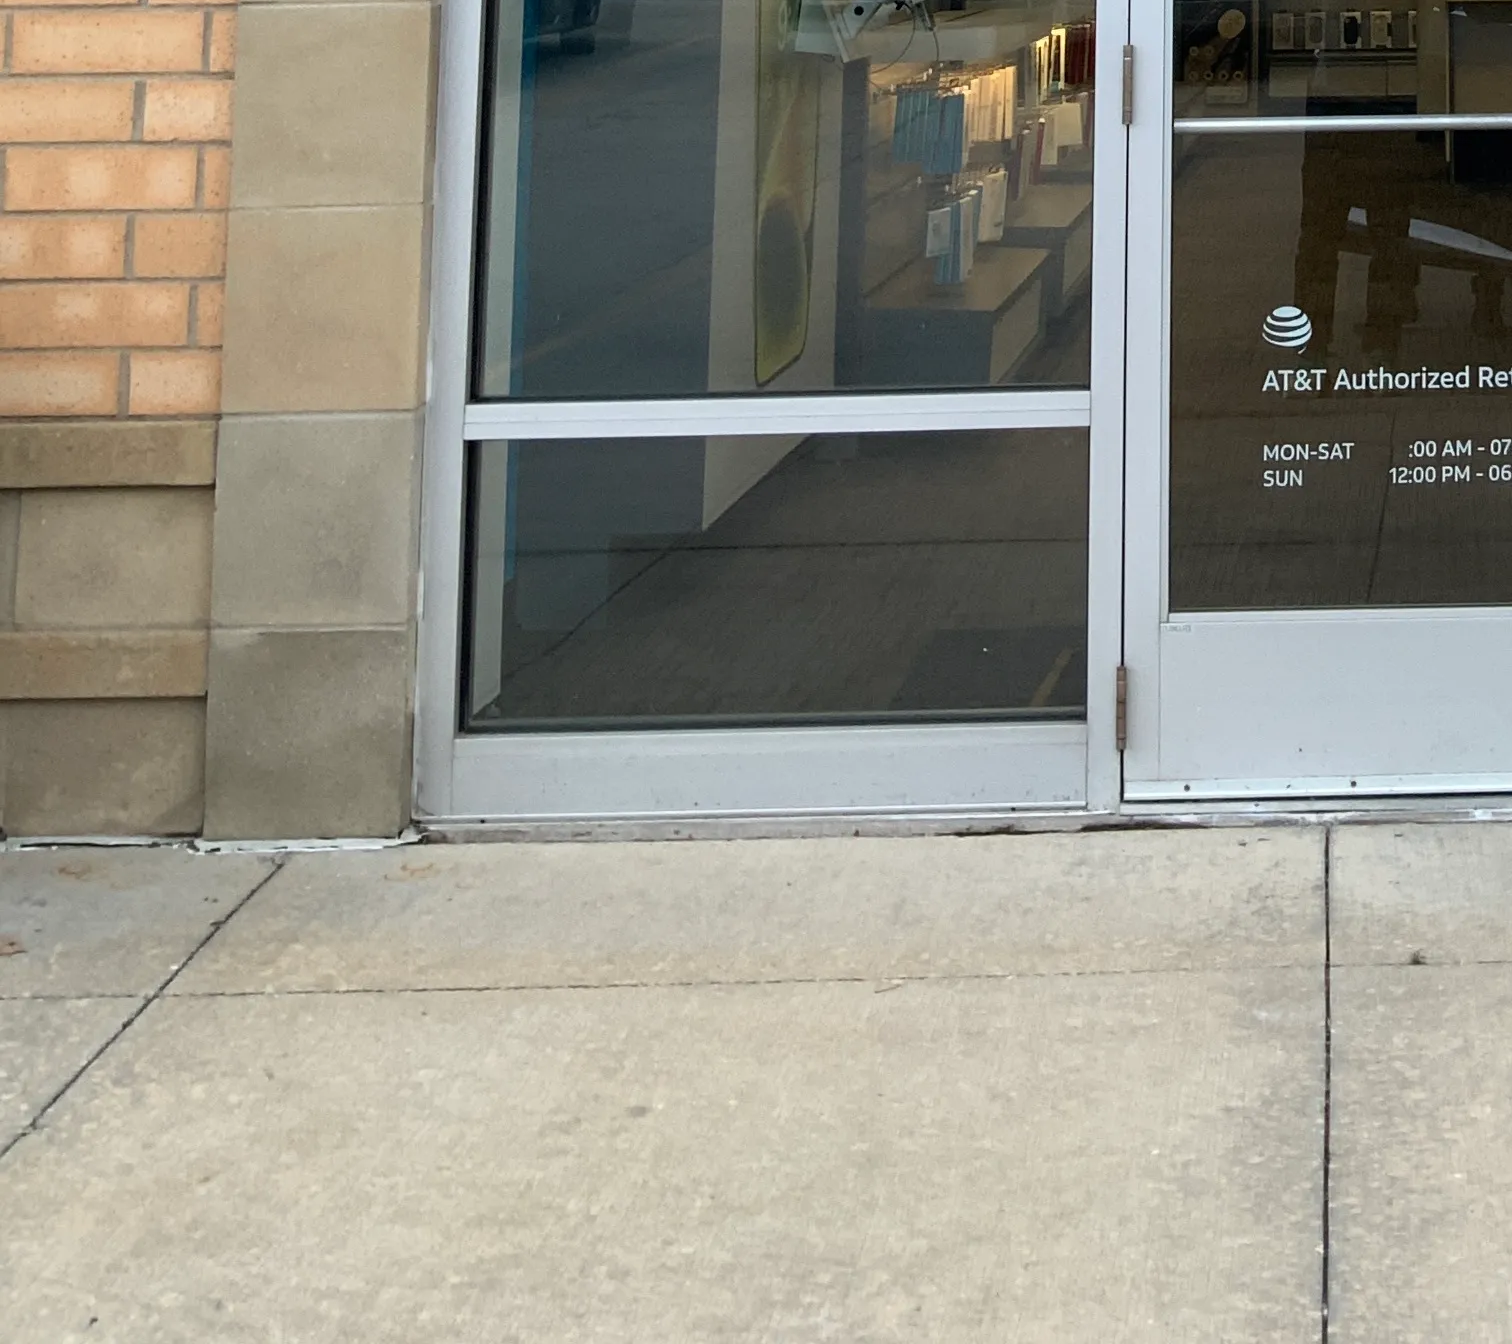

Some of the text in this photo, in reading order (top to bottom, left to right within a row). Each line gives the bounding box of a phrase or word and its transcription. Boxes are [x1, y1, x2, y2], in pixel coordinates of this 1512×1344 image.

[1262, 369, 1327, 392] AT&T
[1334, 365, 1470, 391] Authorized
[1262, 442, 1354, 462] MON-SAT
[1441, 439, 1472, 457] AM
[1262, 469, 1303, 487] SUN
[1388, 466, 1436, 484] 12:00
[1441, 466, 1470, 483] PM
